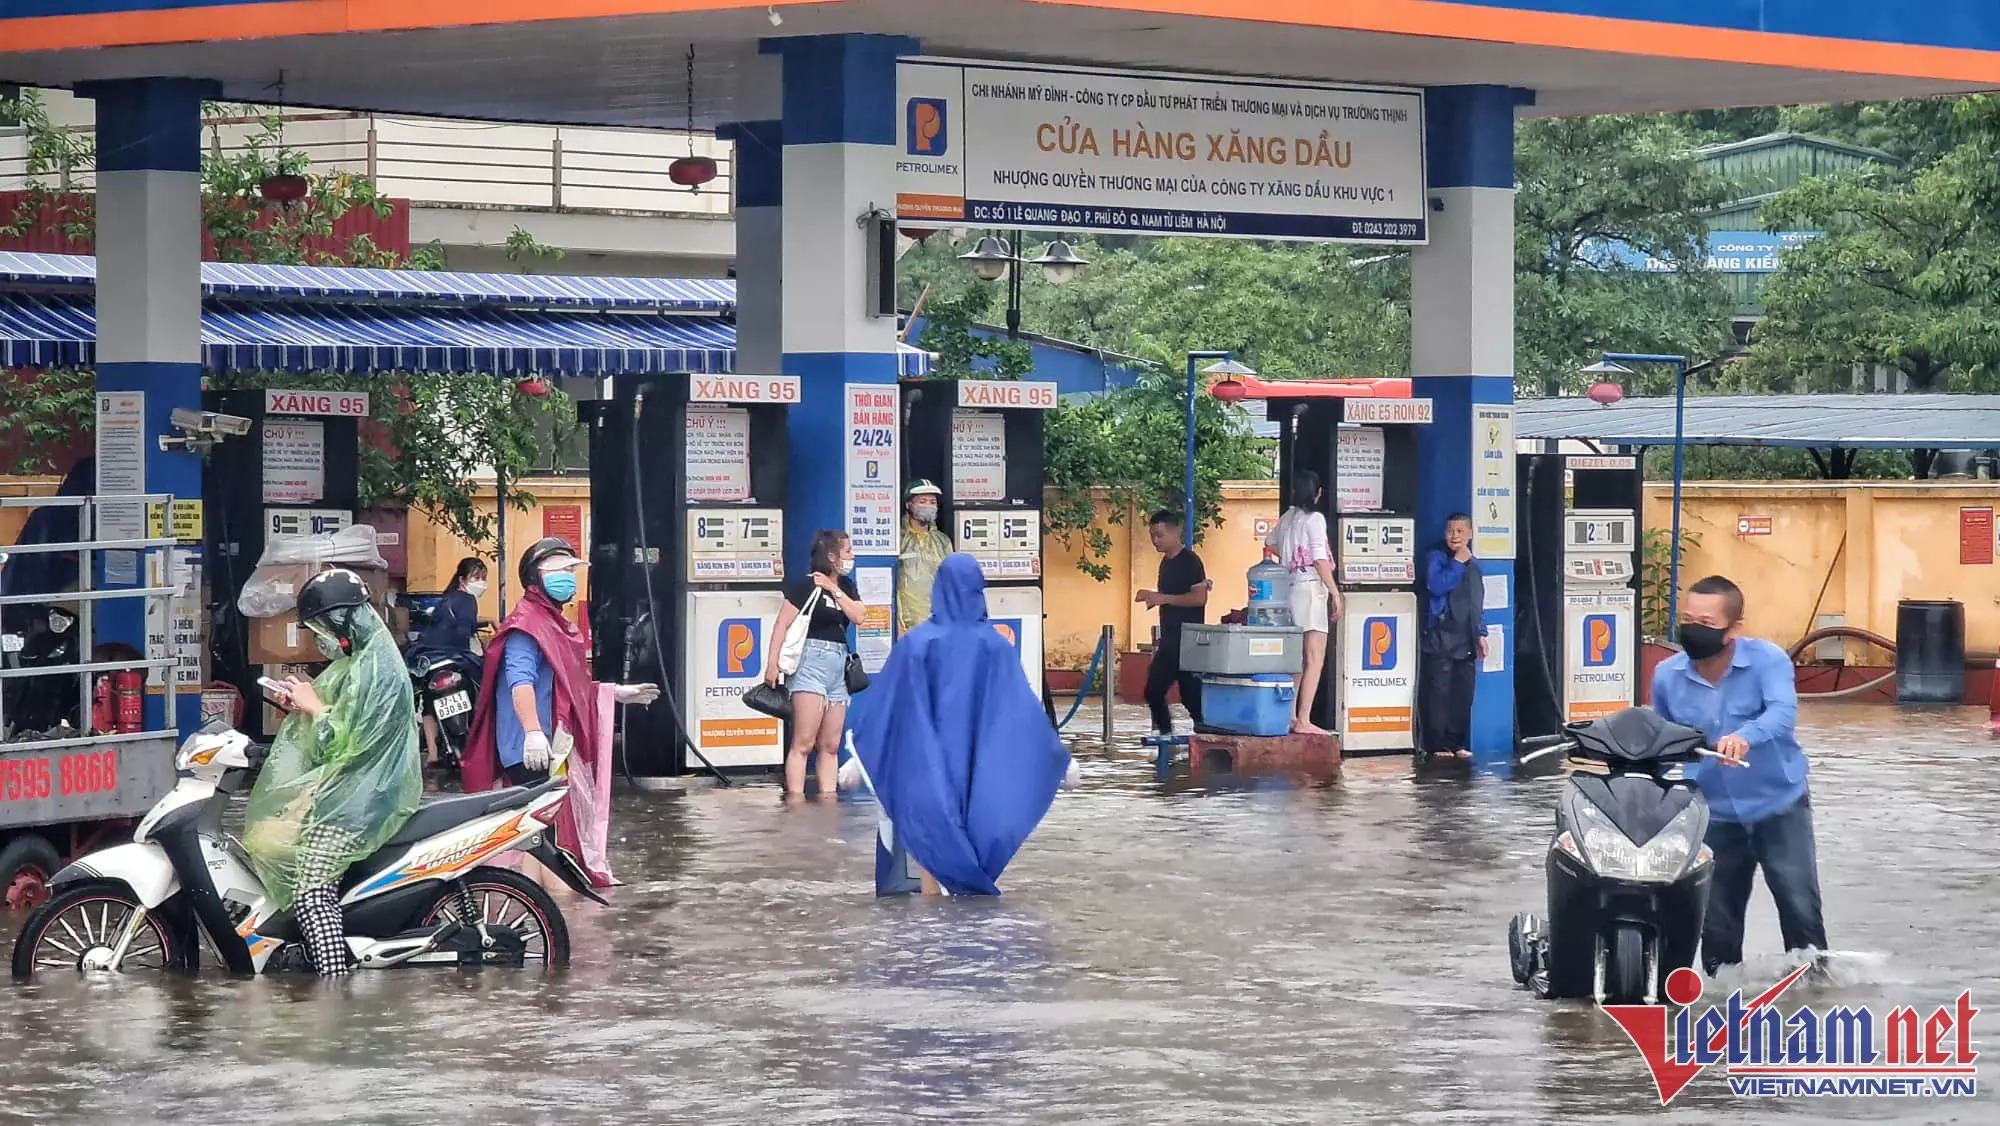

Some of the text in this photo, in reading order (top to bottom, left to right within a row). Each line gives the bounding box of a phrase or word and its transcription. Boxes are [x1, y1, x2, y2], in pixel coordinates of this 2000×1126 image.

[972, 84, 989, 97] CHI
[991, 84, 1026, 99] NHÁNH
[1028, 85, 1043, 101] MỸ
[1044, 87, 1068, 102] ĐÌNH
[1076, 89, 1104, 105] CÔNG
[1107, 93, 1120, 106] TY
[1122, 94, 1134, 107] CP
[1136, 89, 1156, 109] ĐẦU
[1160, 96, 1173, 110] TƯ
[1173, 96, 1198, 111] PHÁT
[1201, 91, 1227, 112] TRIỂN
[1231, 99, 1270, 115] THƯƠNG
[1272, 102, 1288, 118] MẠI
[1290, 100, 1303, 116] VÀ
[1305, 104, 1326, 120] DỊCH
[1328, 106, 1340, 121] VỤ
[1381, 108, 1407, 124] THỊNH
[1037, 115, 1352, 168] CỬA HÀNG XĂNG DẦU
[896, 162, 959, 175] PETROLIMEX
[994, 170, 1048, 189] NHƯỢNG
[1053, 168, 1096, 190] QUYỀN
[1099, 175, 1152, 192] THƯƠNG
[1156, 178, 1177, 195] MẠI
[1181, 174, 1207, 194] CỦA
[1211, 178, 1247, 196] CÔNG
[1250, 182, 1264, 196] TY
[1268, 180, 1302, 197] XĂNG
[1334, 187, 1358, 200] KHU
[1361, 186, 1385, 205] VỰC
[1388, 188, 1394, 202] 1
[992, 203, 1005, 220] SỐ
[1013, 205, 1024, 221] LÊ
[1024, 208, 1057, 222] QUANG
[1061, 210, 1081, 224] ĐẠO
[1094, 209, 1111, 225] PHÚ
[1142, 214, 1162, 228] NAM
[1175, 213, 1193, 229] LIÊM
[1197, 215, 1209, 230] HÀ
[1210, 215, 1226, 231] NỘI
[1364, 223, 1383, 235] 0243
[1384, 223, 1398, 236] 202
[1399, 224, 1417, 237] 3979
[1718, 244, 1755, 252] CÔNG
[696, 376, 795, 400] XĂNG 95
[964, 384, 1053, 406] XĂNG 95
[271, 392, 364, 414] XĂNG 95
[854, 393, 893, 408] THỜI GIAN
[853, 410, 894, 426] BÁN HÀNG
[1347, 401, 1431, 421] XĂNG E5 RON 92
[953, 420, 965, 433] HÚ
[853, 429, 893, 447] 24/24
[273, 515, 280, 534] 9
[311, 515, 323, 534] 10
[698, 517, 706, 538] 8
[741, 518, 750, 539] 7
[964, 519, 971, 540] 6
[1003, 519, 1011, 539] 5
[1346, 524, 1353, 544] 4
[1588, 522, 1595, 541] 2
[1605, 522, 1611, 541] 1
[1382, 526, 1389, 544] 3
[149, 632, 164, 644] TRÁC
[1352, 677, 1407, 687] PETROLIMEX
[1574, 673, 1625, 683] PETROLIMEX
[60, 749, 117, 797] 8868
